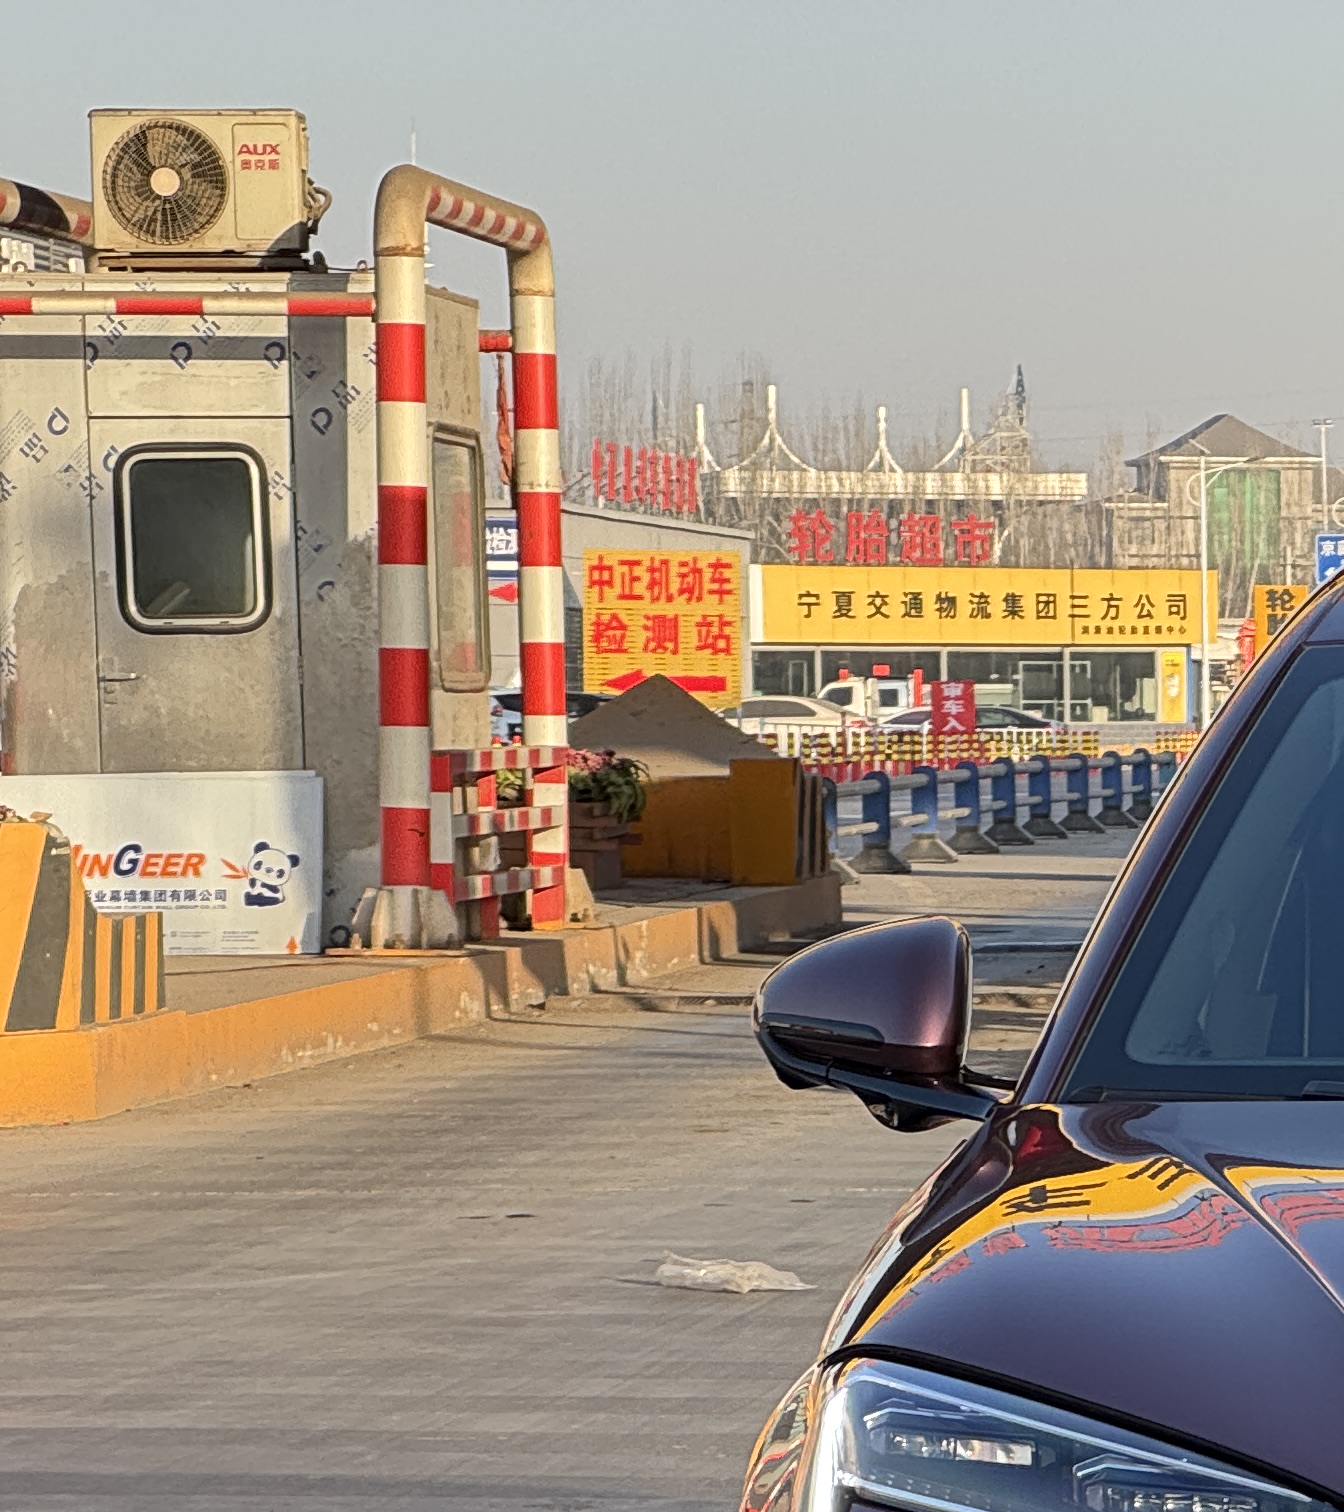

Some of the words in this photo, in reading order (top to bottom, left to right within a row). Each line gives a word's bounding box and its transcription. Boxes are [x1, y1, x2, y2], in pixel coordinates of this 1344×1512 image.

[237, 143, 281, 155] AUX
[786, 507, 997, 566] 轮胎超市
[587, 553, 734, 605] 中正机动车
[797, 590, 1189, 622] 宁夏交通物流集团三方公司
[590, 612, 733, 656] 检测站
